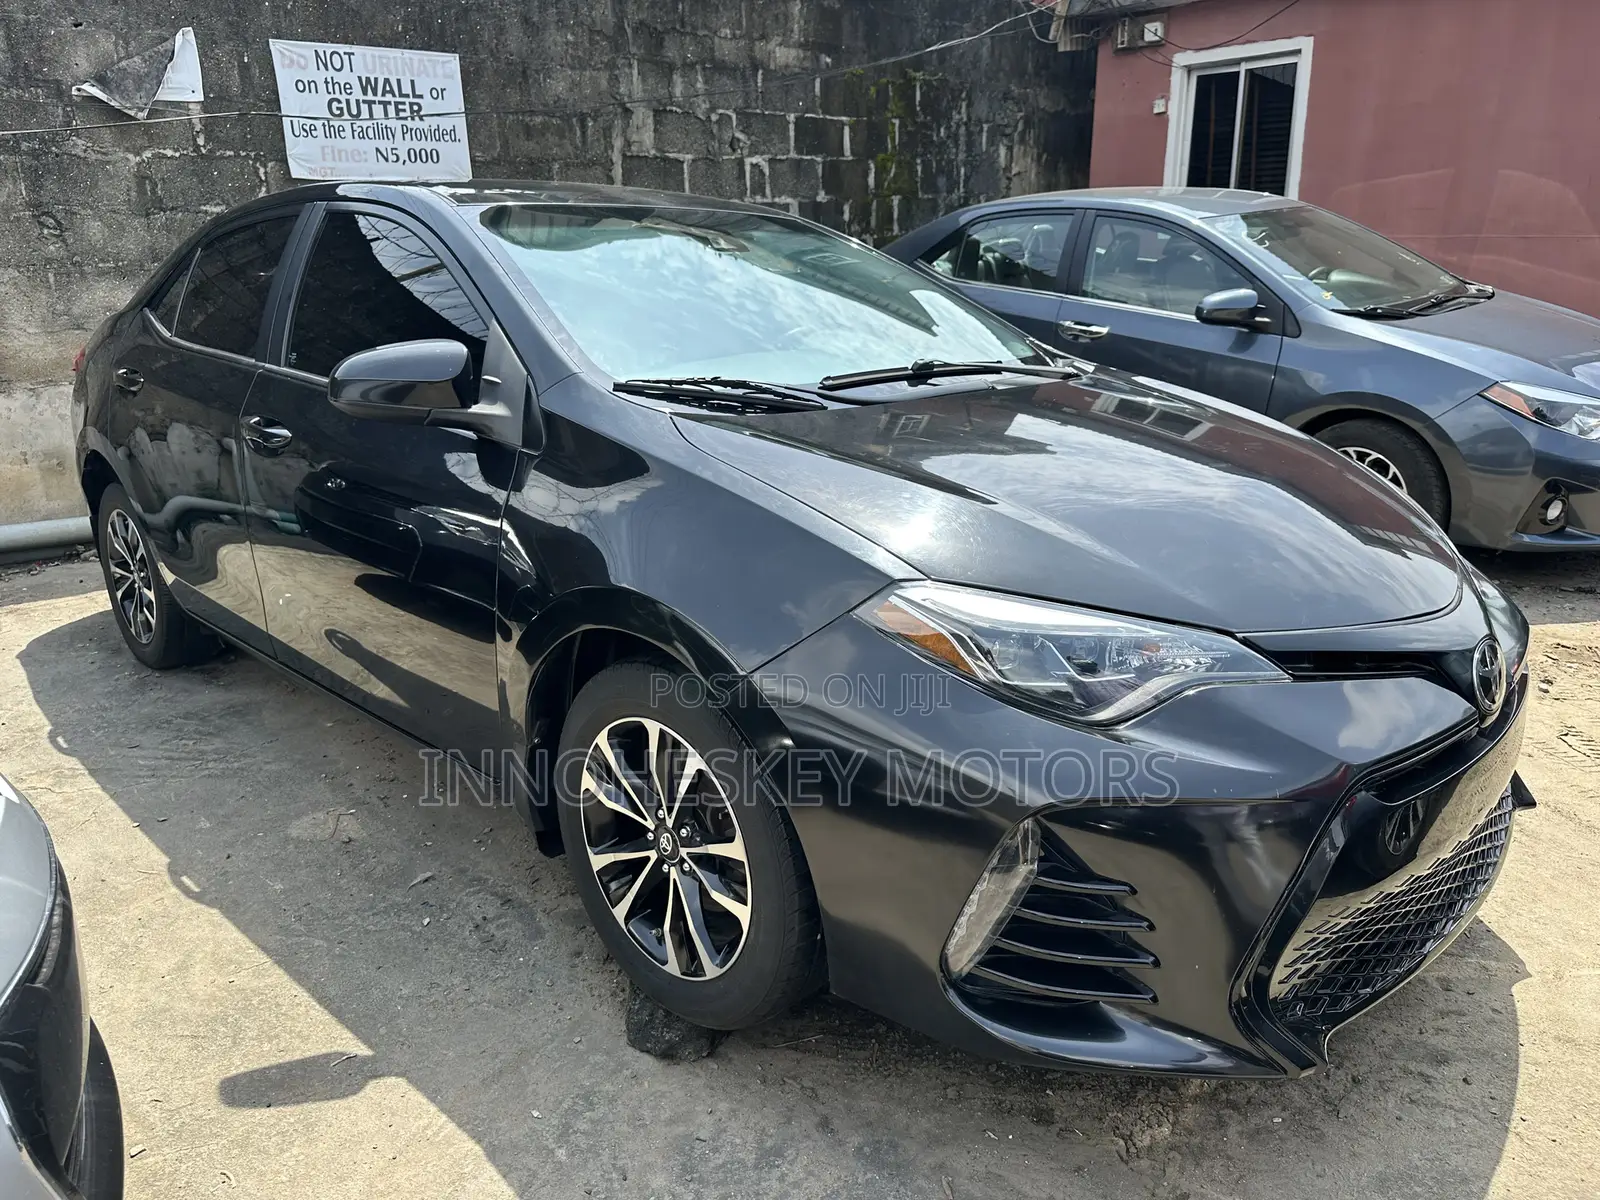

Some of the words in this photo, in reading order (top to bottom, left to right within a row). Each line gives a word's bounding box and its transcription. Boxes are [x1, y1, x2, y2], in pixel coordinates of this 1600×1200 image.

[314, 49, 355, 73] NOT
[361, 52, 455, 80] URINATE
[294, 78, 319, 95] on
[324, 76, 354, 96] the
[357, 76, 424, 100] WALL
[429, 87, 447, 101] or
[327, 97, 425, 121] GUTTER
[290, 119, 318, 139] Use
[322, 120, 346, 140] the
[351, 122, 397, 145] Facility
[402, 124, 462, 143] Provided.
[320, 145, 369, 163] Fine:
[374, 146, 441, 166] N5,000
